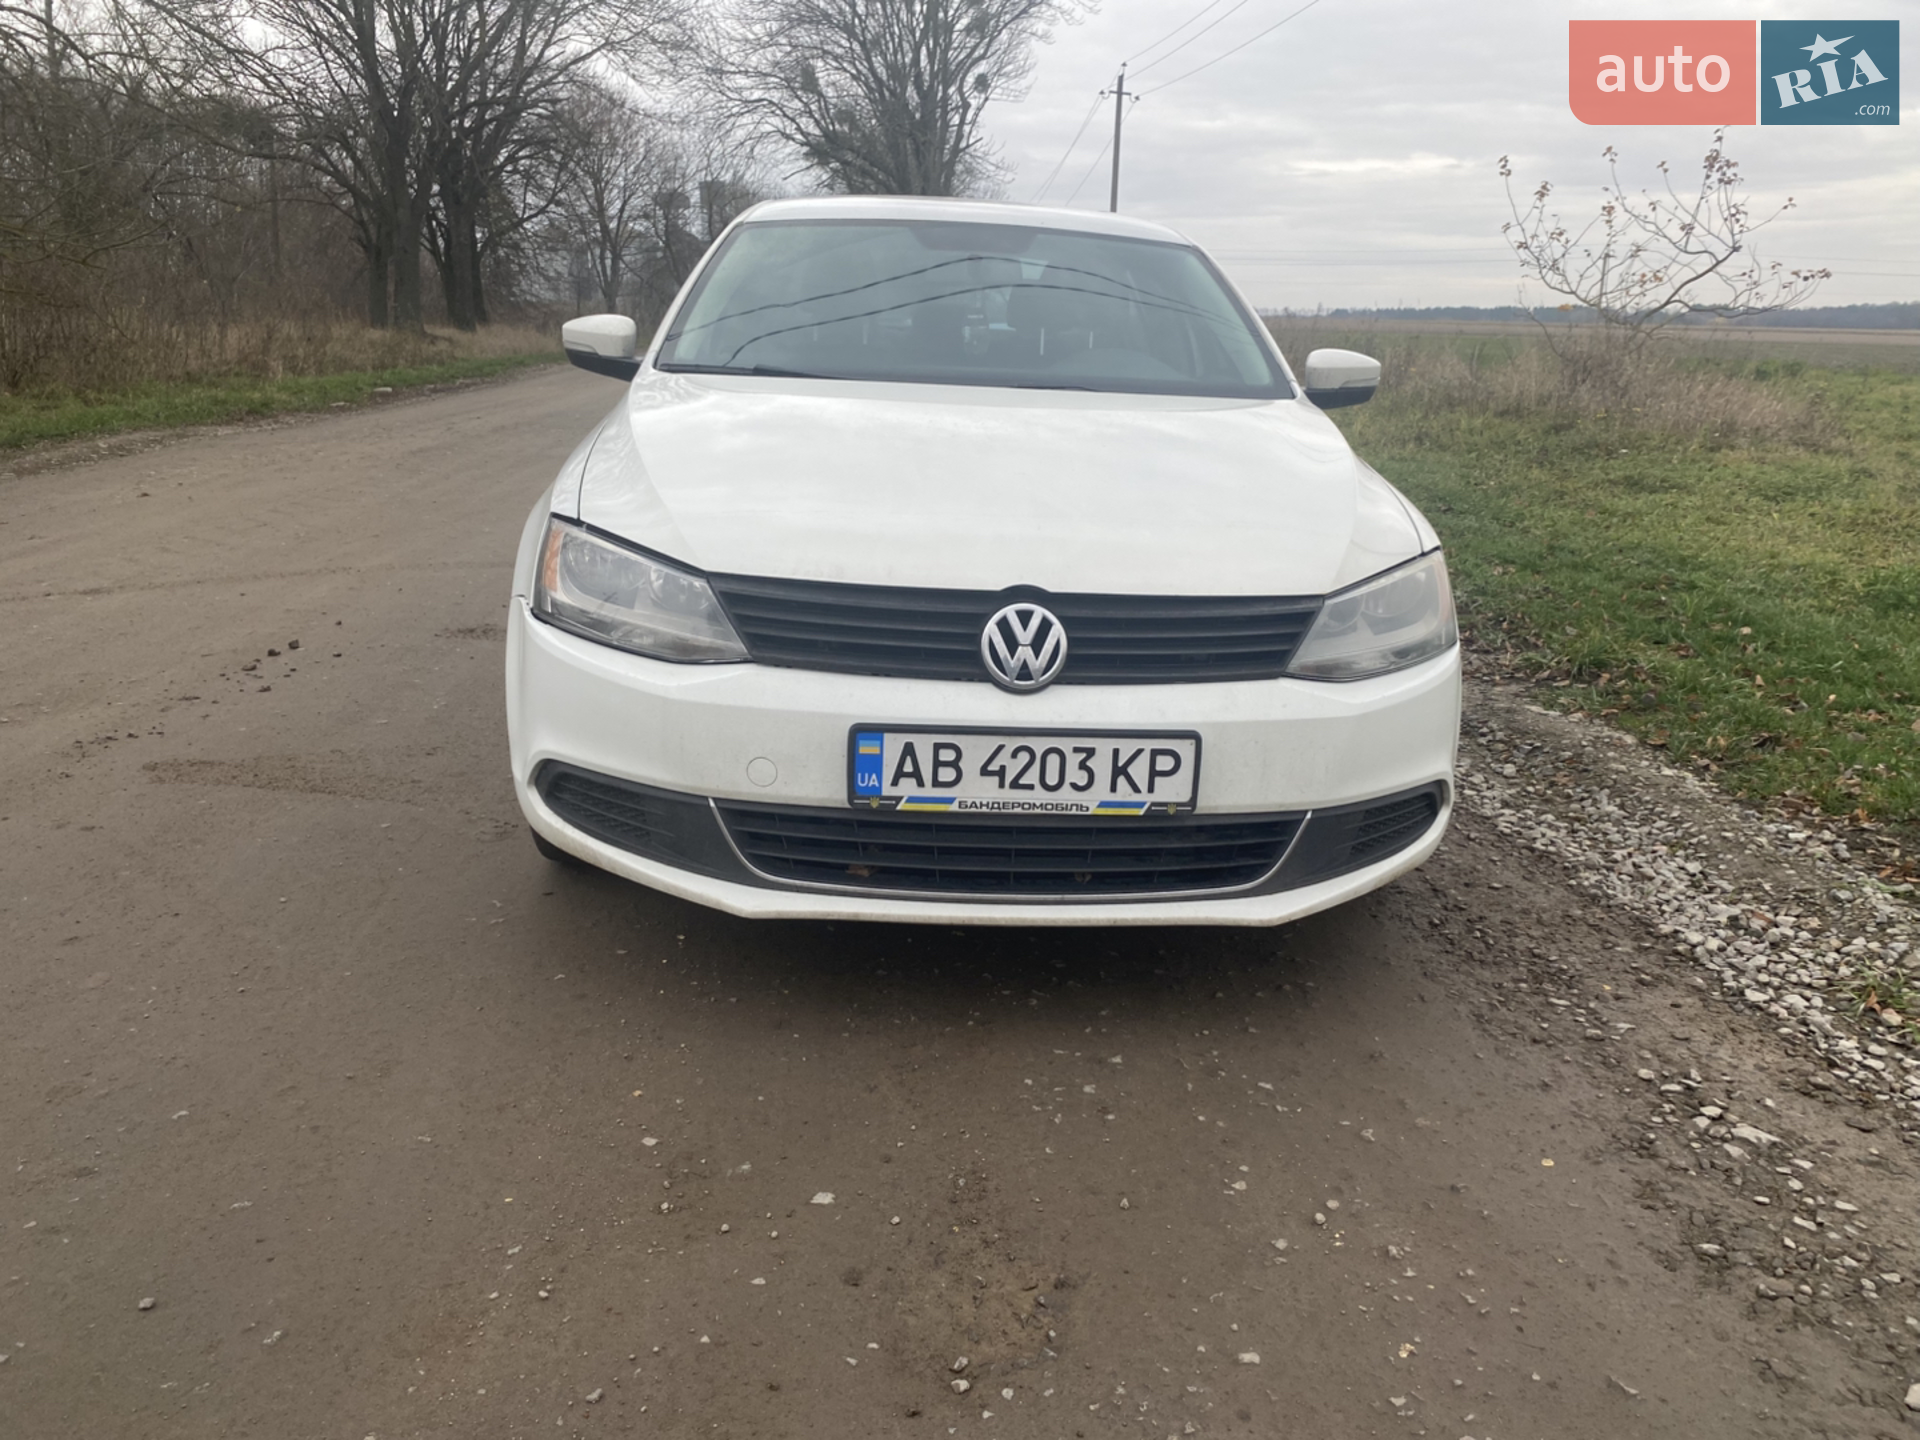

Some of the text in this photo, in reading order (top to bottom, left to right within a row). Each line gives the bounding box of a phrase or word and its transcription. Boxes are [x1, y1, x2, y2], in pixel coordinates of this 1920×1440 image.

[890, 741, 1182, 794] AB 4203 KP
[857, 772, 880, 787] UA
[958, 800, 1090, 813] БАНДЕРОМОБІЛЬ
